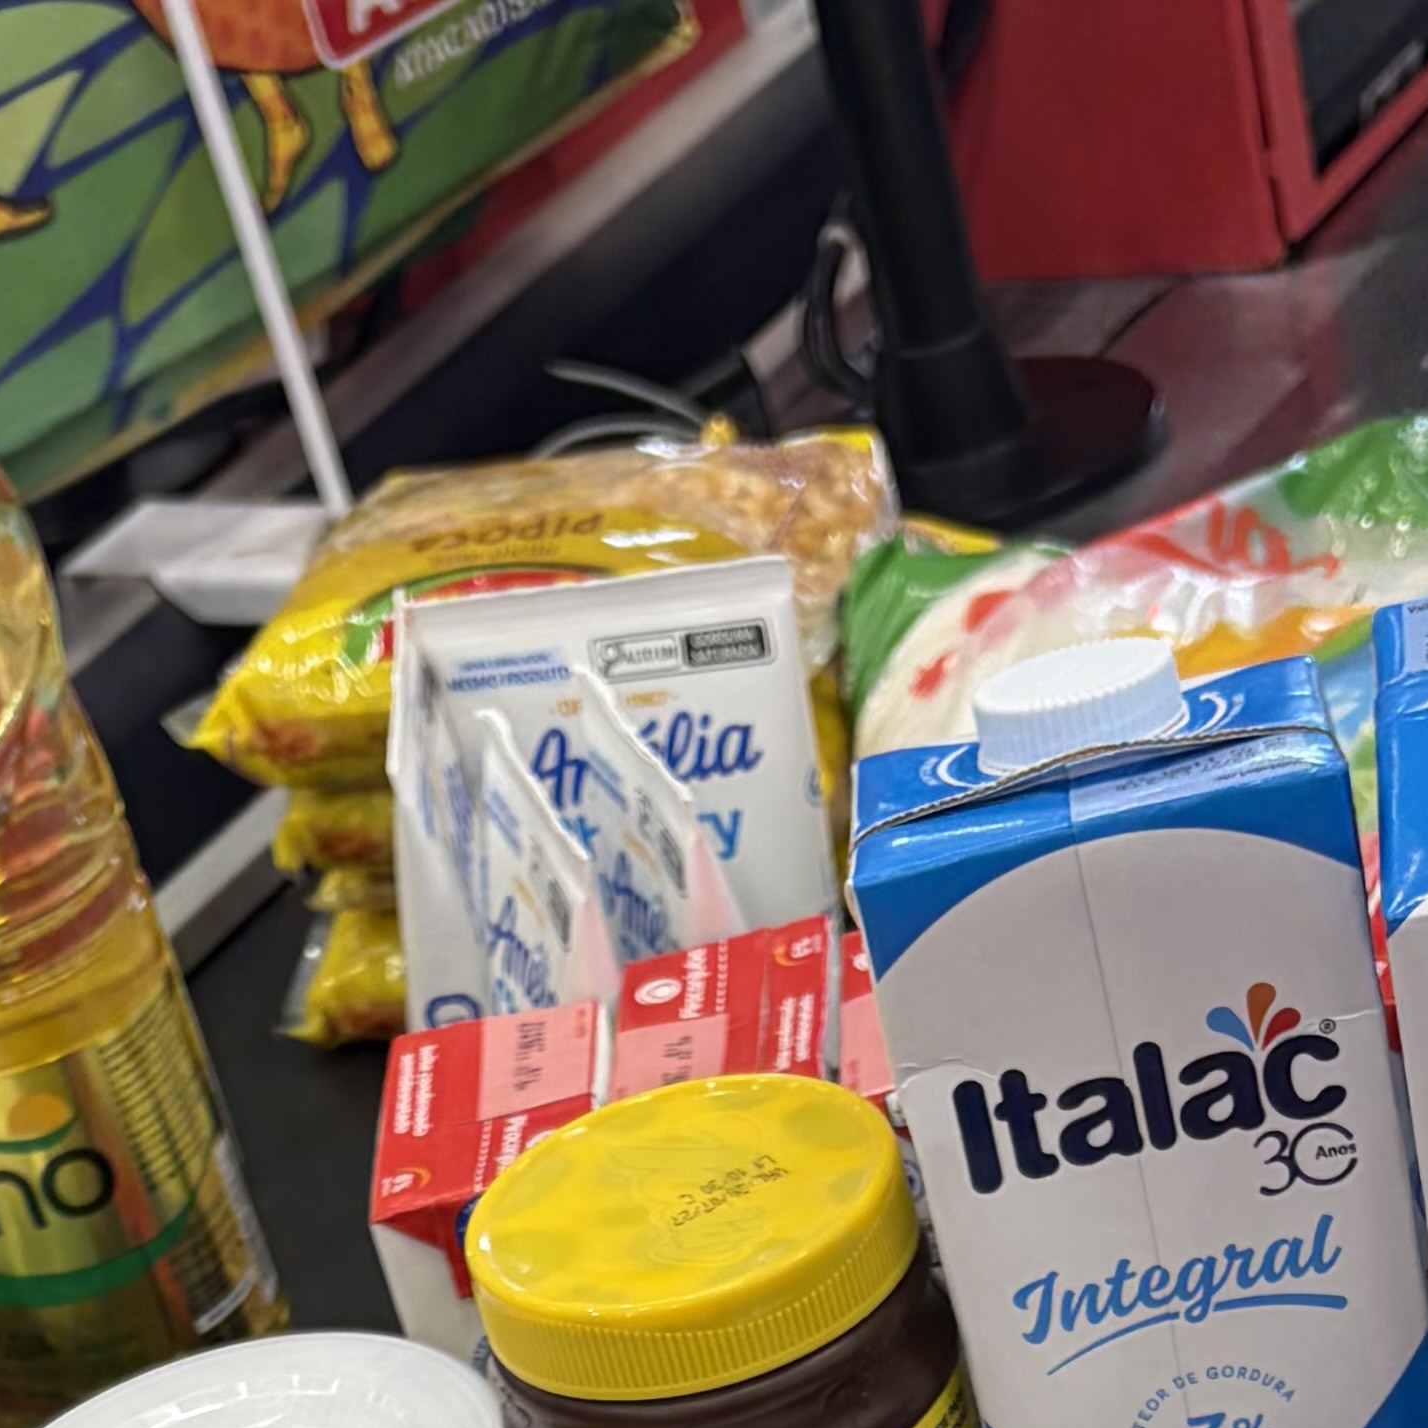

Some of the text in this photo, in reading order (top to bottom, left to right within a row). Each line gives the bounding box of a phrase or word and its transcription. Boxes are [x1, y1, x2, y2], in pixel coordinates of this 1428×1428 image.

[953, 1033, 1348, 1195] Italac
[1314, 1139, 1357, 1162] Anos
[1012, 1213, 1342, 1345] Integral
[1172, 1371, 1199, 1391] DE
[1205, 1364, 1297, 1403] GORDURA
